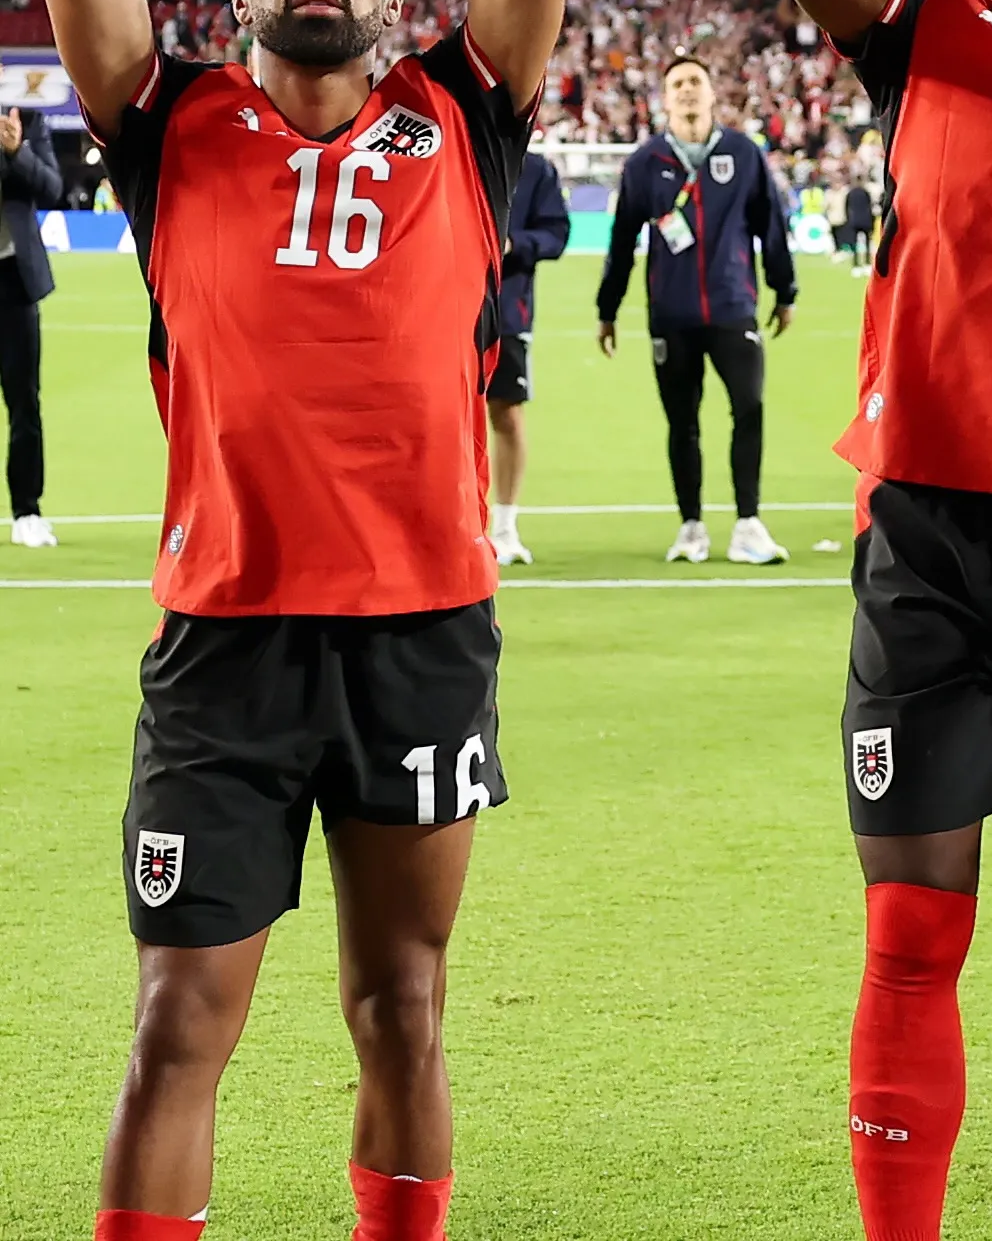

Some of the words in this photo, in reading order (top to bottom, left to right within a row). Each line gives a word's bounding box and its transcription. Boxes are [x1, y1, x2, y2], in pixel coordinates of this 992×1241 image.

[275, 148, 390, 270] 16
[401, 733, 490, 825] 16
[851, 1114, 908, 1142] ÖFB
